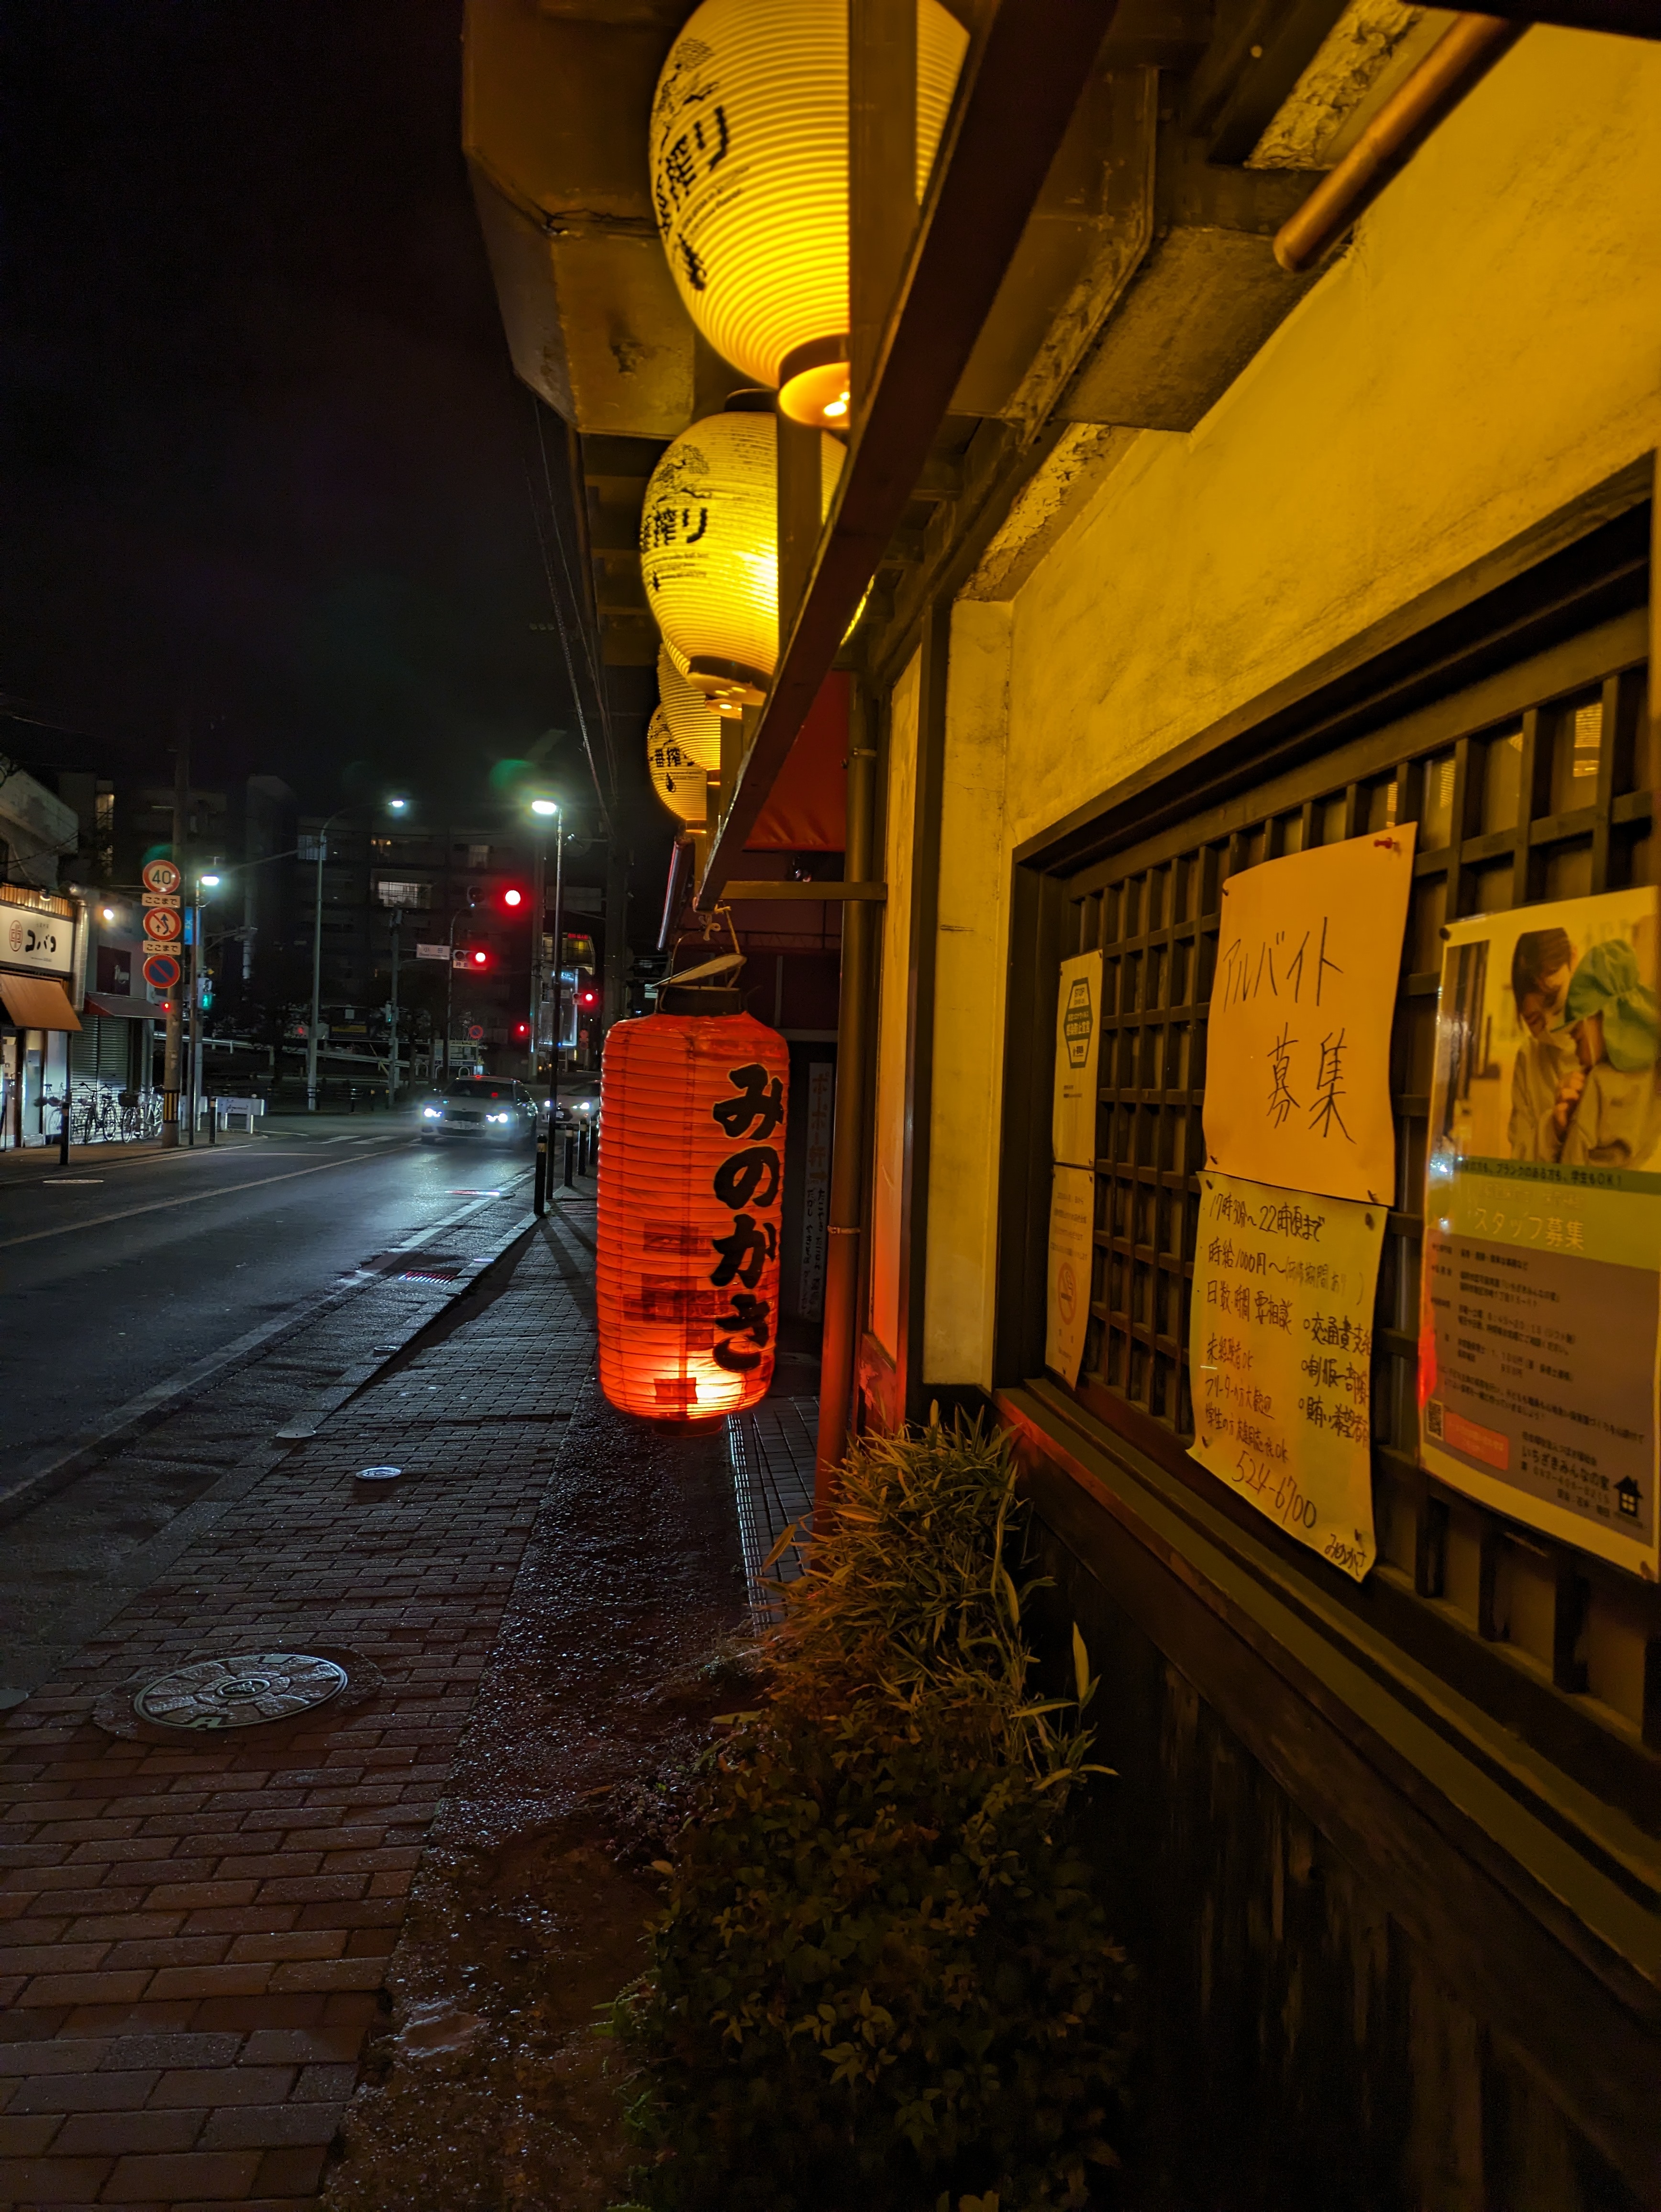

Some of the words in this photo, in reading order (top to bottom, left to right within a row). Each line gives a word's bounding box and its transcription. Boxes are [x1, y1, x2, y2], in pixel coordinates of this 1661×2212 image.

[145, 895, 178, 906] ここまで
[152, 870, 172, 885] 40
[145, 942, 179, 953] ここまで
[1223, 916, 1344, 1013] アルバイト
[1266, 1022, 1357, 1145] 募集
[710, 1063, 785, 1372] みのかさ
[1474, 1207, 1584, 1251] スタッフ募集
[1231, 1450, 1318, 1529] 524-6700
